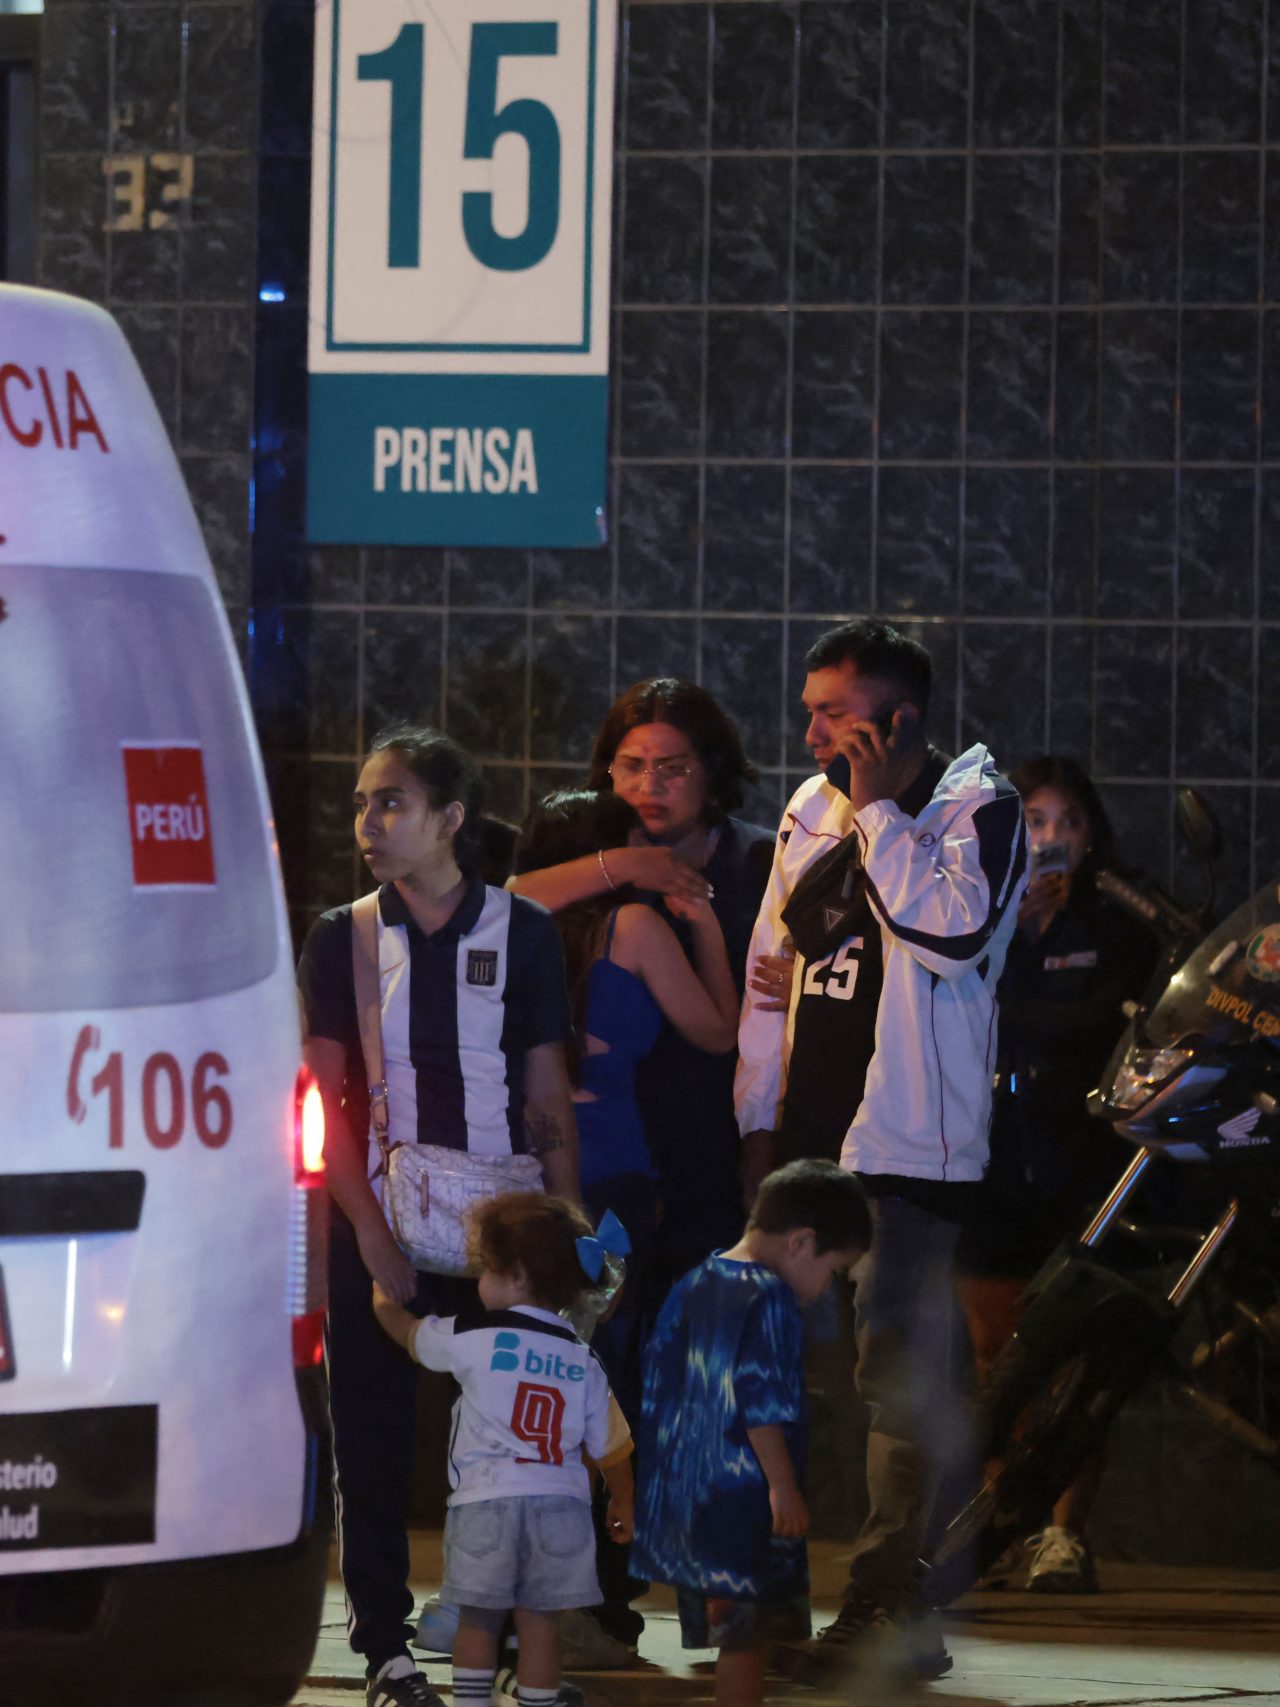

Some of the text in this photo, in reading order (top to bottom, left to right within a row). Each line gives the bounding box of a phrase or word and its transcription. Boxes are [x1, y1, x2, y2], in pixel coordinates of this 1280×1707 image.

[356, 21, 561, 271] 15
[373, 427, 538, 494] PRENSA
[135, 795, 205, 842] PERÚ
[803, 935, 864, 1001] 25
[92, 1050, 233, 1150] 106
[526, 1348, 585, 1382] bite
[510, 1381, 566, 1466] 9
